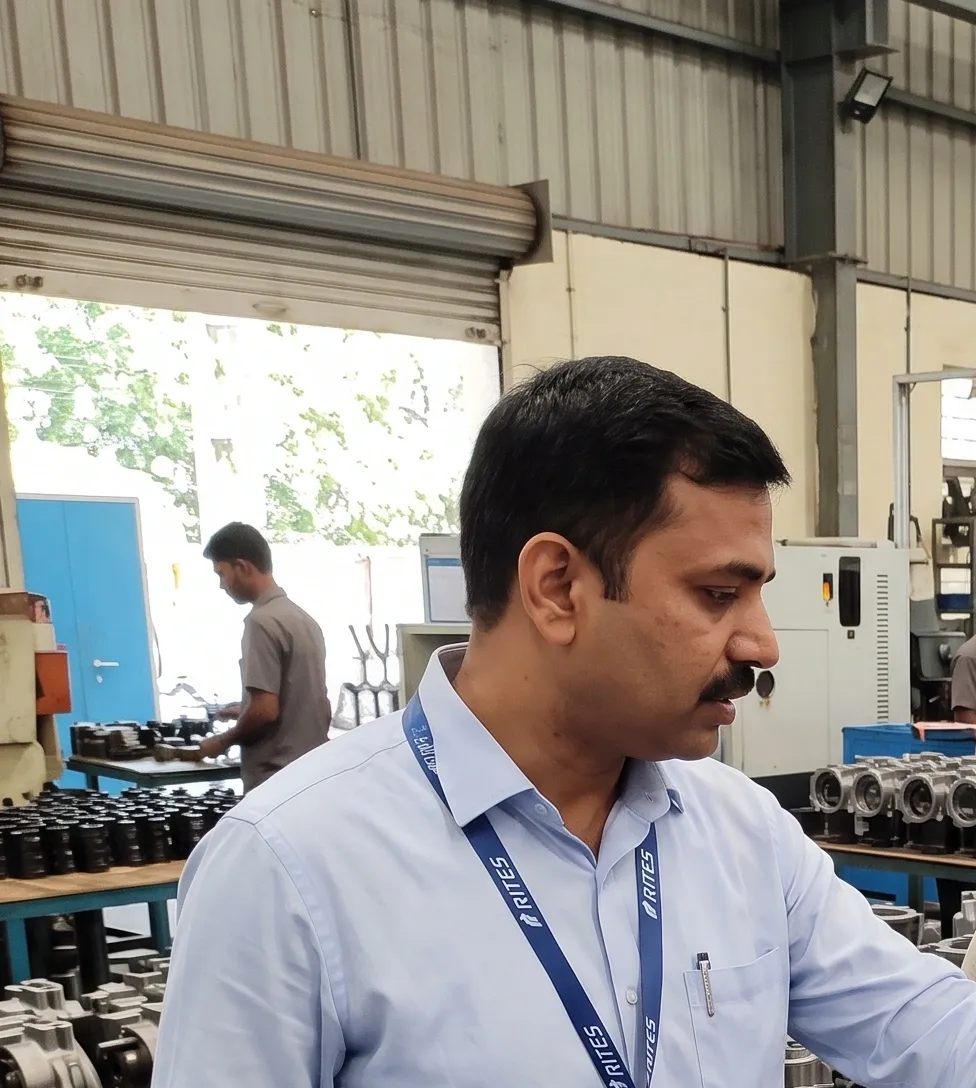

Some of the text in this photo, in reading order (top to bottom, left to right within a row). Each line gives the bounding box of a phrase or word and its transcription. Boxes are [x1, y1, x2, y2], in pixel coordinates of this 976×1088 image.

[489, 857, 532, 910] RITES
[641, 848, 657, 903] RITES
[583, 1025, 624, 1076] RITES
